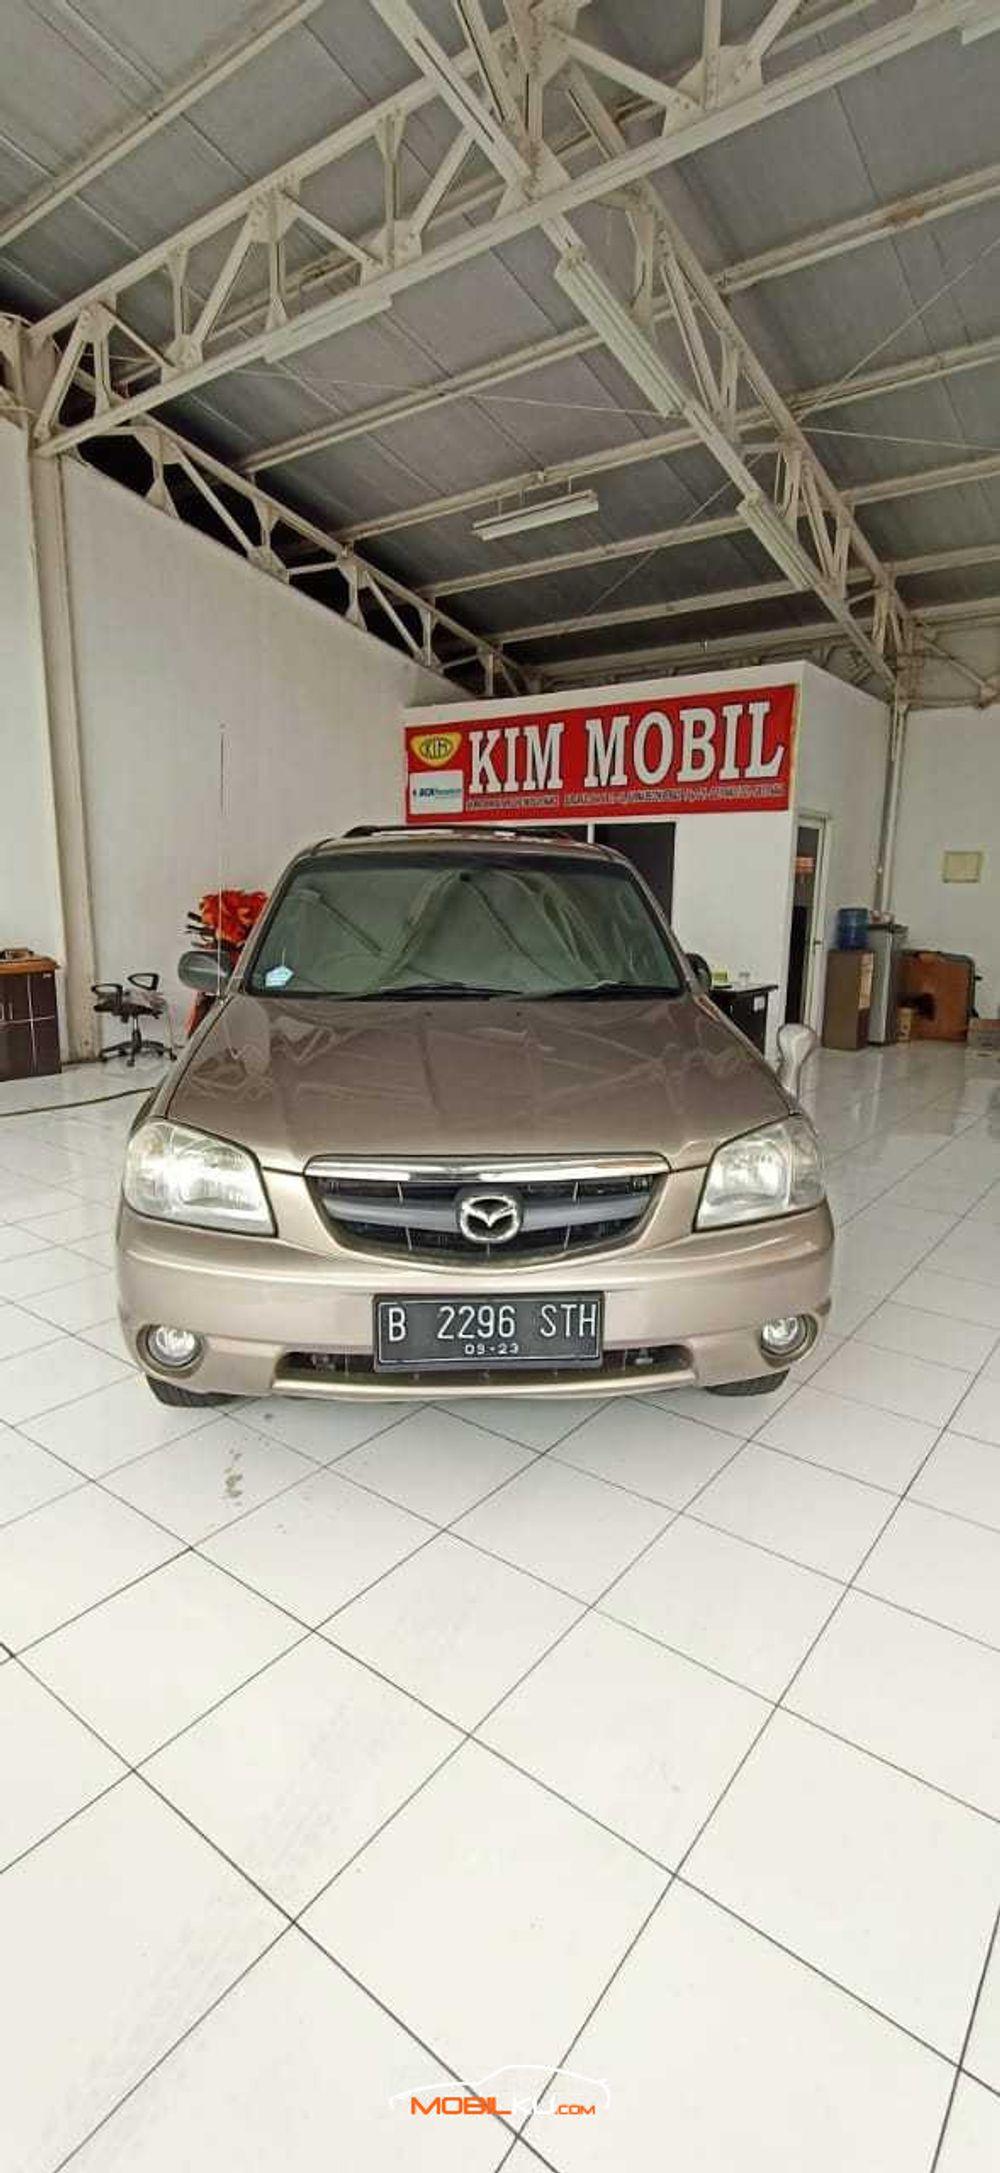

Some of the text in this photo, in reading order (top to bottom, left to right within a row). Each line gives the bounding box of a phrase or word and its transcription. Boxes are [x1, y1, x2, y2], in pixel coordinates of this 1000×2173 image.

[469, 702, 785, 794] KIM MOBIL
[388, 1303, 597, 1342] B 2296 STH
